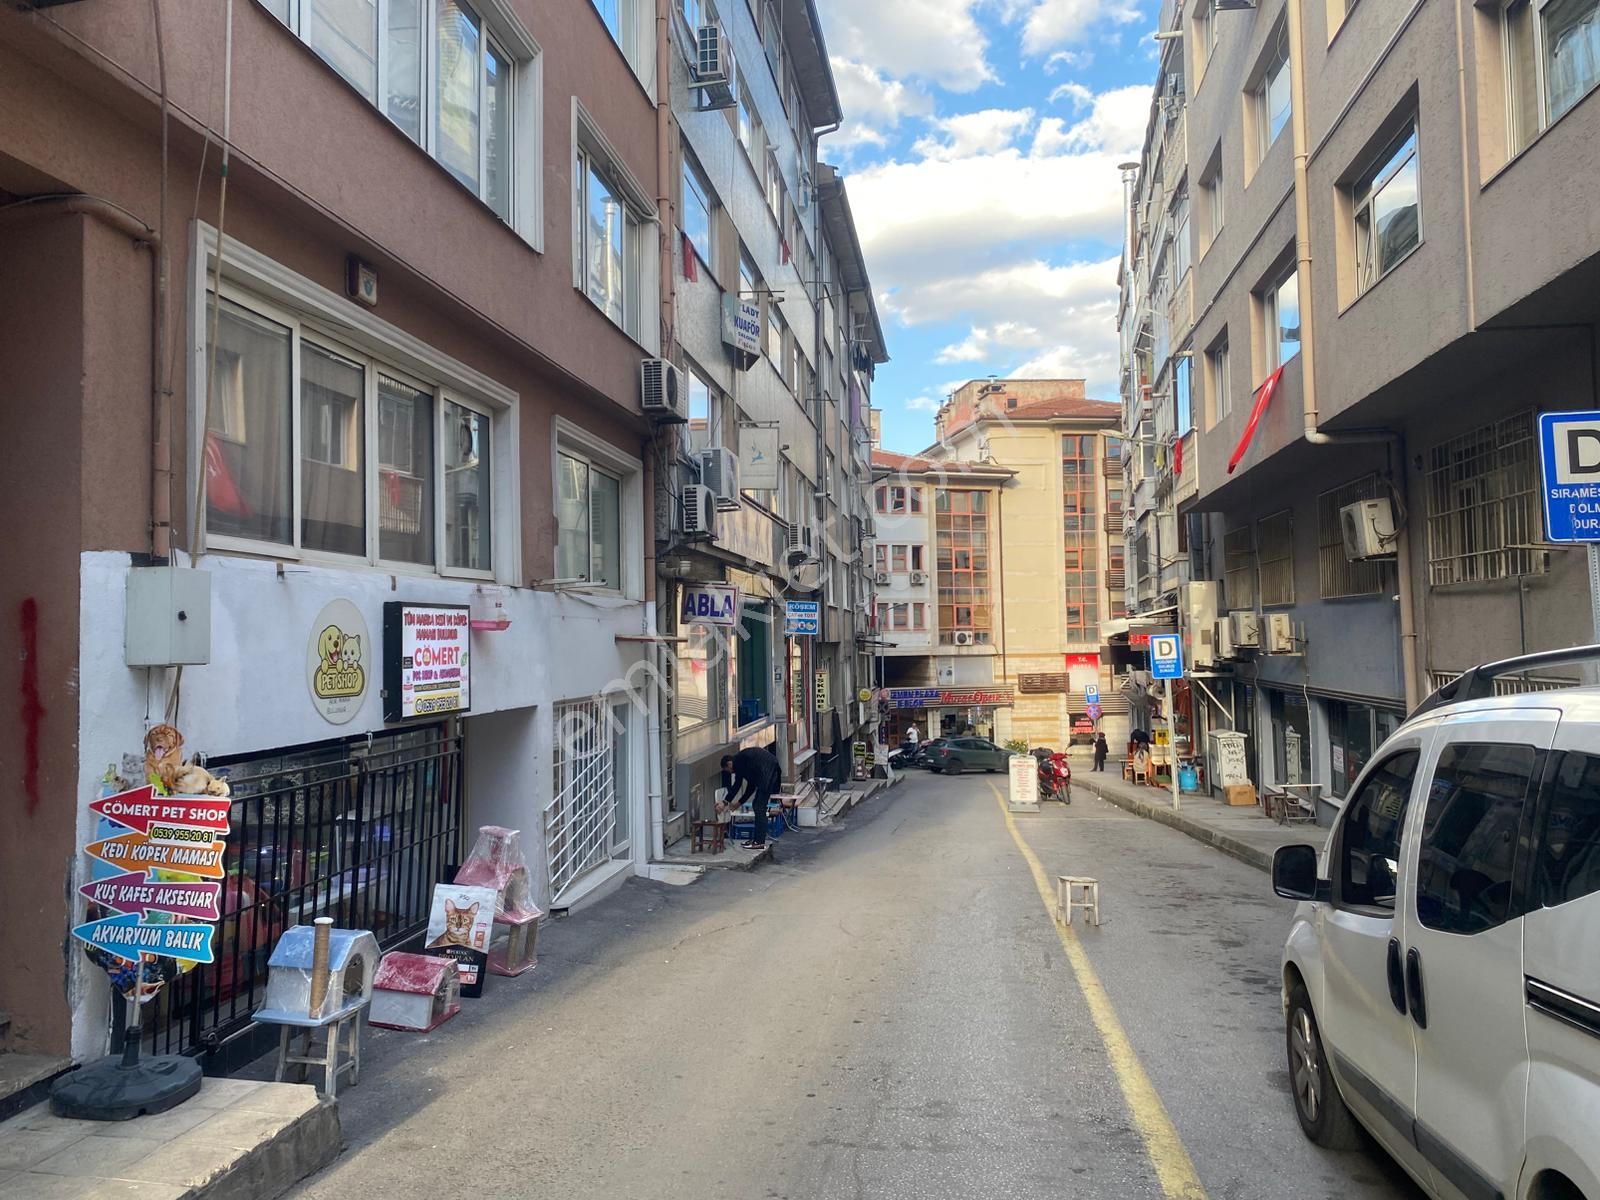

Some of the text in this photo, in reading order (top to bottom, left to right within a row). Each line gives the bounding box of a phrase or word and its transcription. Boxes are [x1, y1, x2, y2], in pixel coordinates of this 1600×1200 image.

[742, 304, 759, 318] LADY
[734, 315, 760, 337] KUAFÖR
[1567, 429, 1600, 474] D
[684, 593, 733, 618] ABLA
[414, 645, 460, 667] CÖMERT
[1159, 641, 1173, 657] D
[321, 671, 358, 690] PET SHOP
[1088, 687, 1095, 695] D
[102, 799, 228, 822] CÖMERT PET SHOP
[151, 827, 213, 844] 0539 955 20 81
[101, 841, 220, 867] KEDİ KÖPEK MAMASI
[94, 884, 213, 909] KUŞ KAFES AKSESUAR
[92, 925, 204, 951] AKVARYUM BALIK
